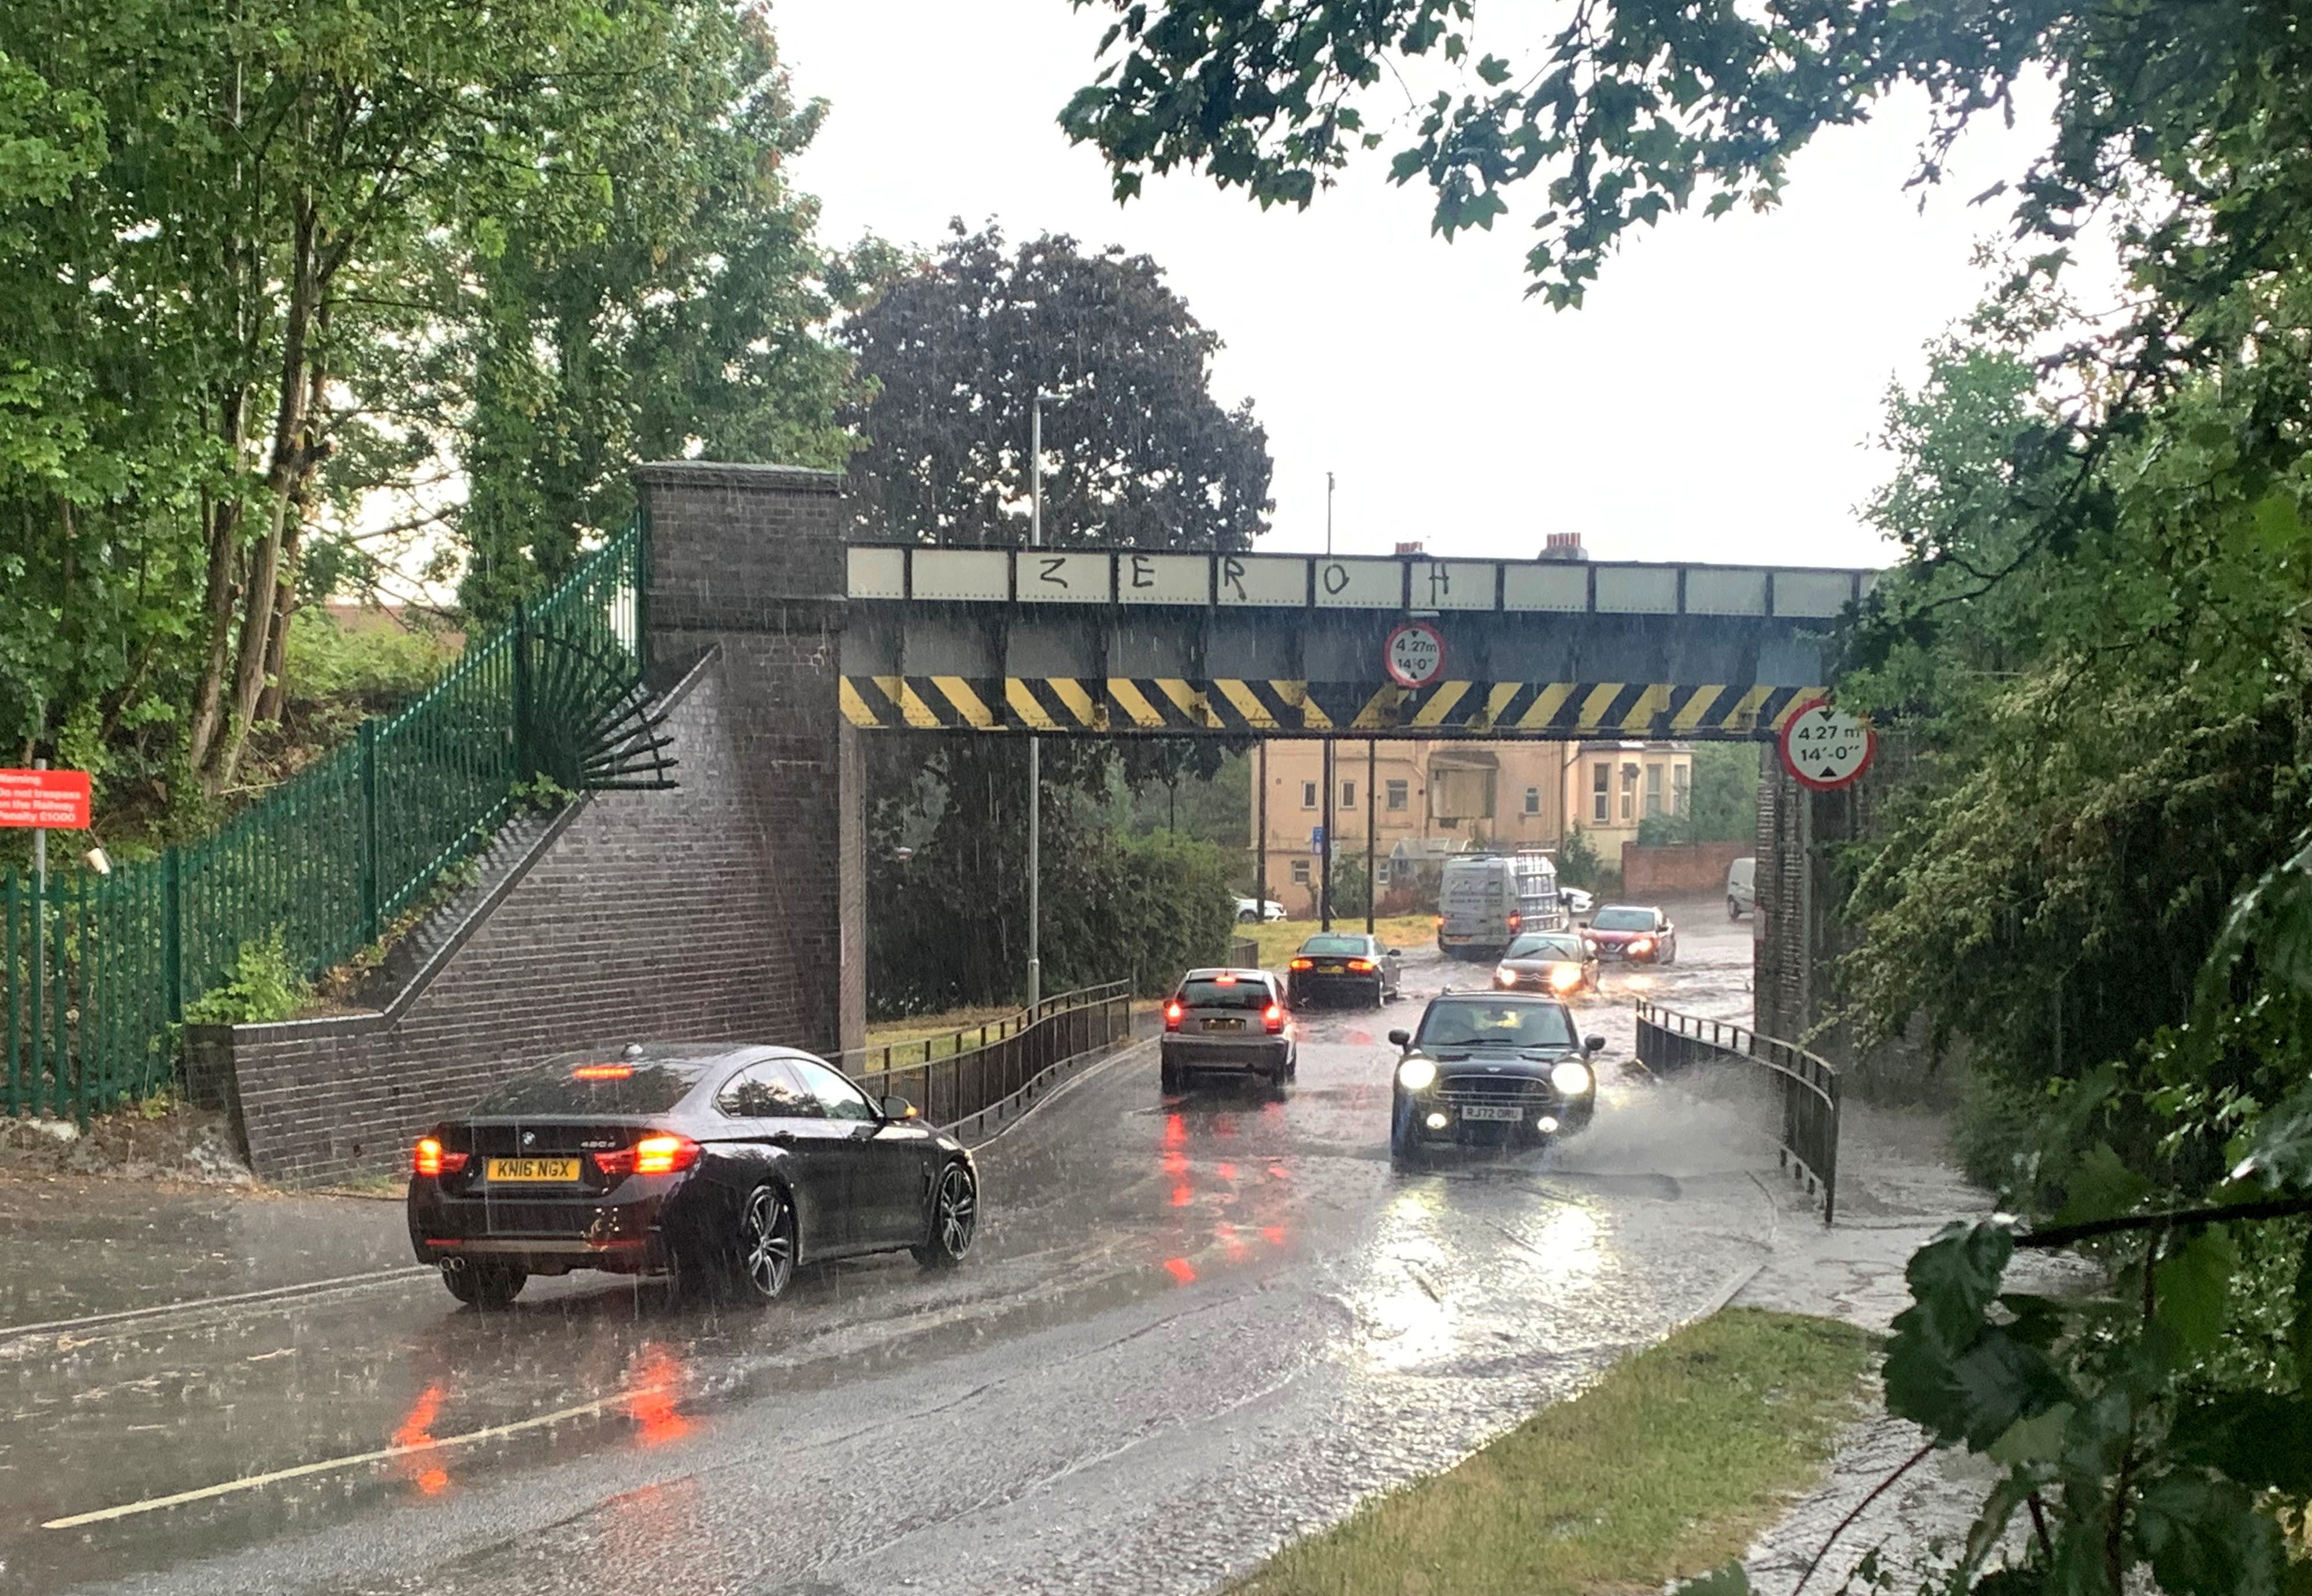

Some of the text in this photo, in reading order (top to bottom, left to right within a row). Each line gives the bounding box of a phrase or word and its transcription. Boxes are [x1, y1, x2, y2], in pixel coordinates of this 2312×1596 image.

[34, 789, 81, 800] trespass
[498, 1161, 570, 1177] KN16 NGX
